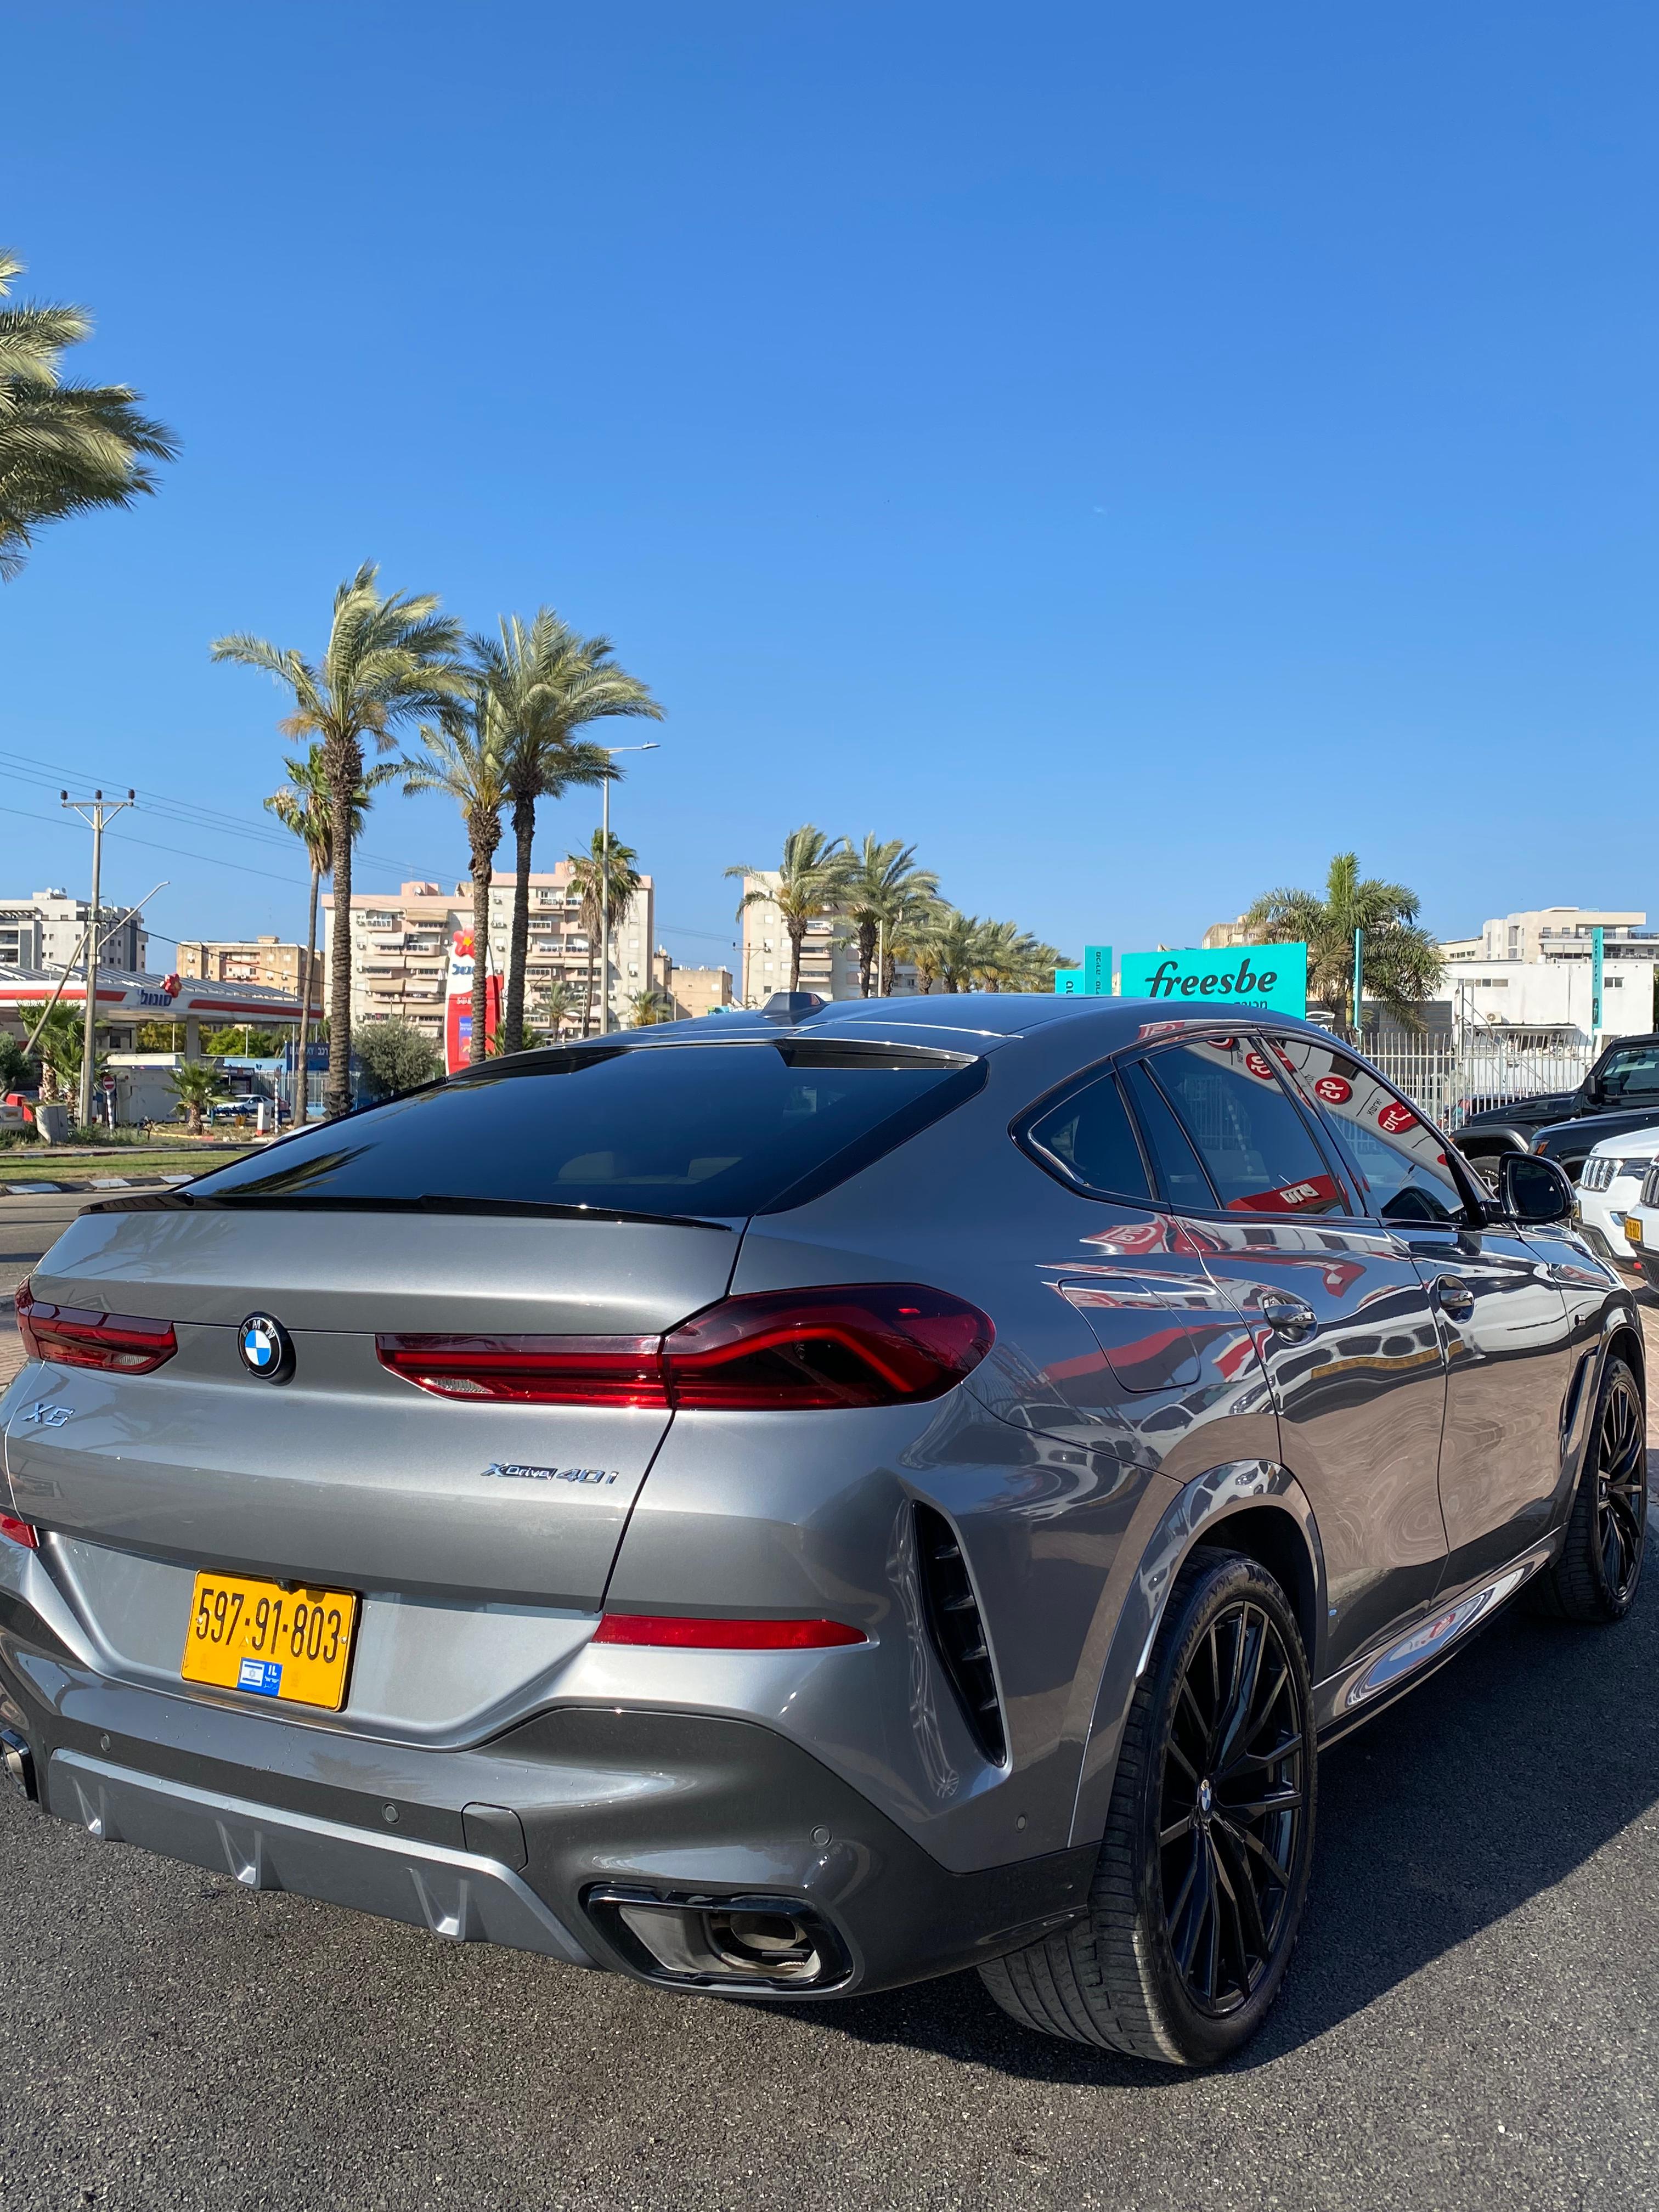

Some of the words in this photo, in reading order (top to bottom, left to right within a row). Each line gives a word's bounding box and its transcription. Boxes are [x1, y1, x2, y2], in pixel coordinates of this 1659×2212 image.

[1145, 958, 1278, 998] freesbe
[140, 989, 172, 1007] סונול
[241, 1319, 275, 1339] BMW
[21, 1402, 75, 1427] X6
[268, 1664, 278, 1677] IL
